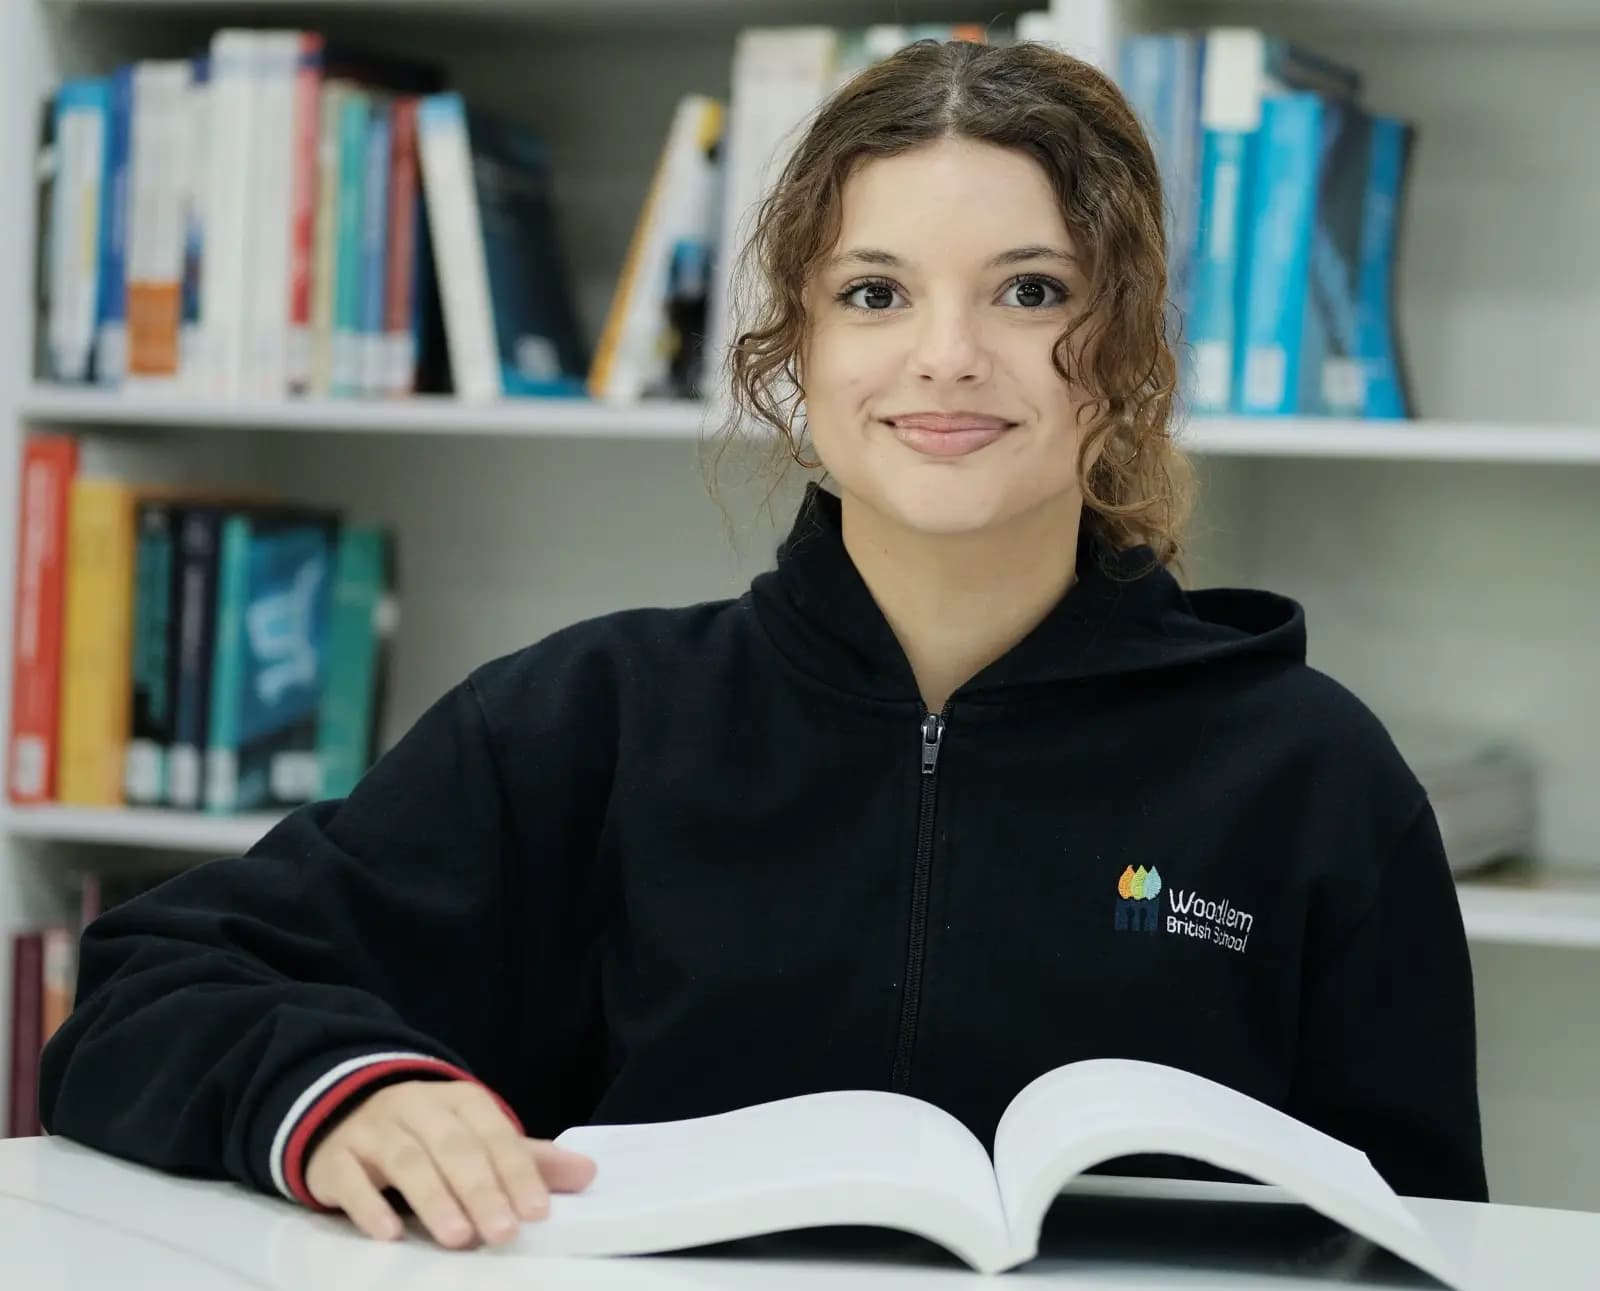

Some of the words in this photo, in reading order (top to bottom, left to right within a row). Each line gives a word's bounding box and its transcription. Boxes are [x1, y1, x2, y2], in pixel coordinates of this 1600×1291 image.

[1169, 888, 1253, 933] Woodlem
[1166, 916, 1211, 940] British
[1213, 926, 1248, 953] School
